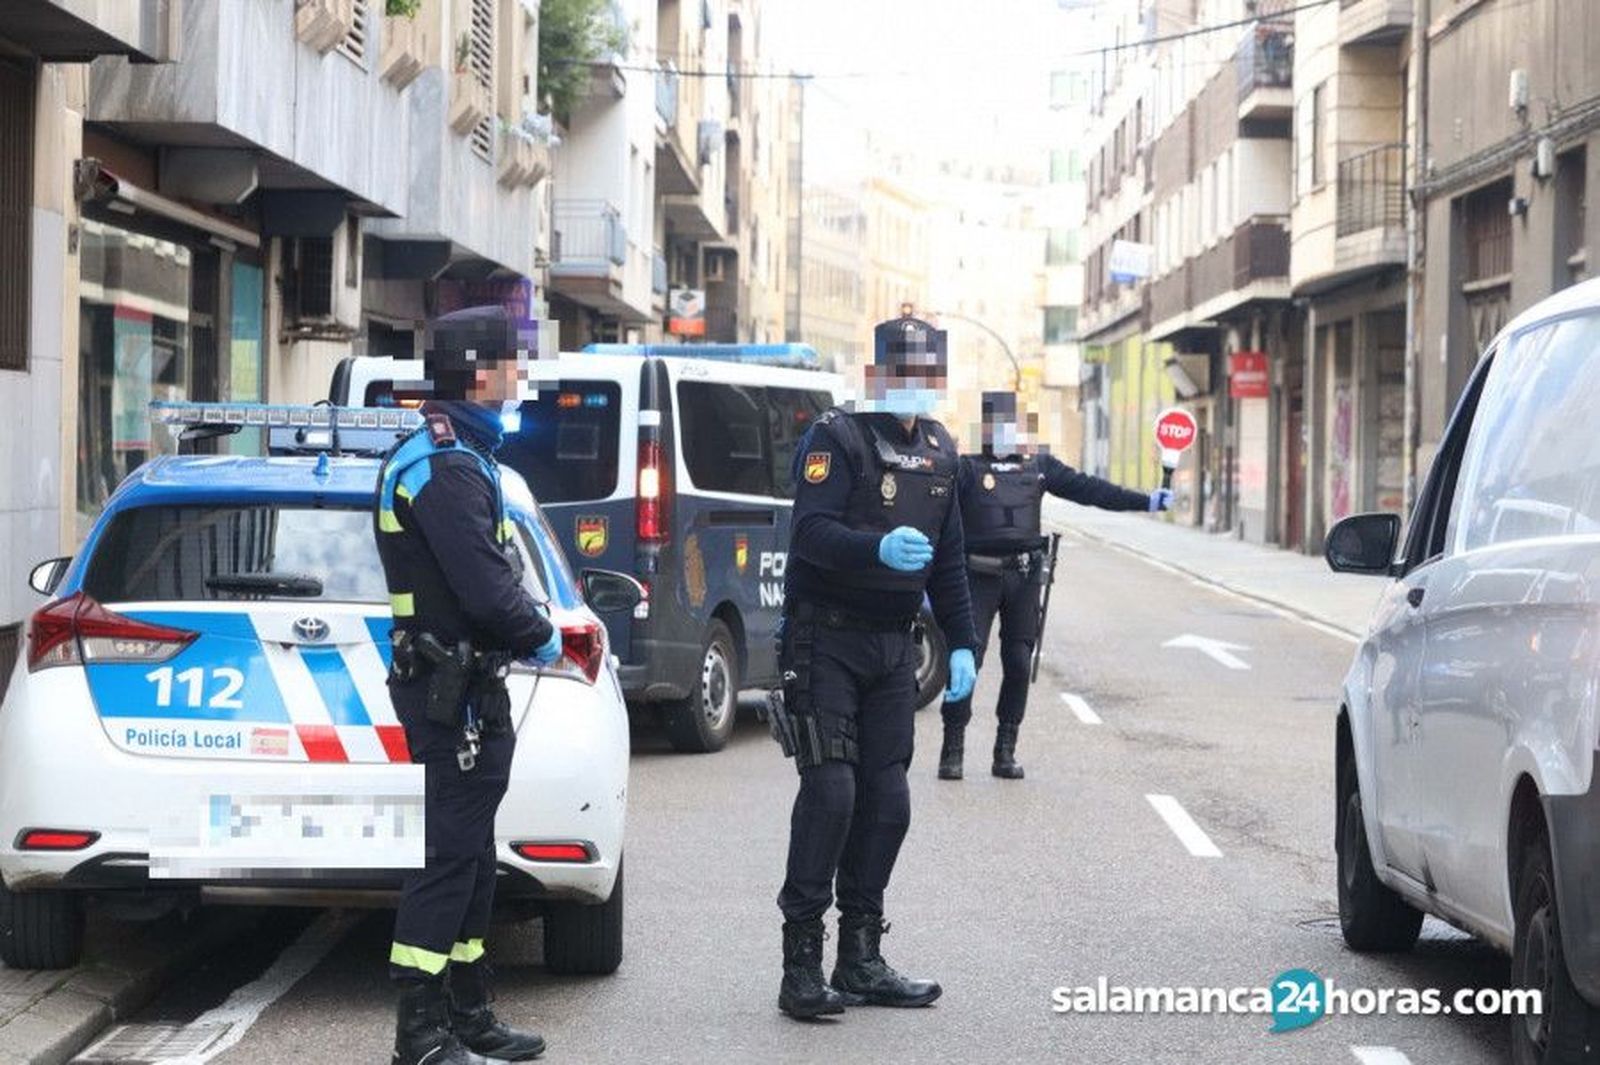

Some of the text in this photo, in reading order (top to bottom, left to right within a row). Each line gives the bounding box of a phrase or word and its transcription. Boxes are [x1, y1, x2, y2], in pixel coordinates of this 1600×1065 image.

[1160, 422, 1192, 438] STOP
[760, 582, 786, 607] NA
[145, 666, 245, 709] 112
[126, 728, 241, 749] Policía Local
